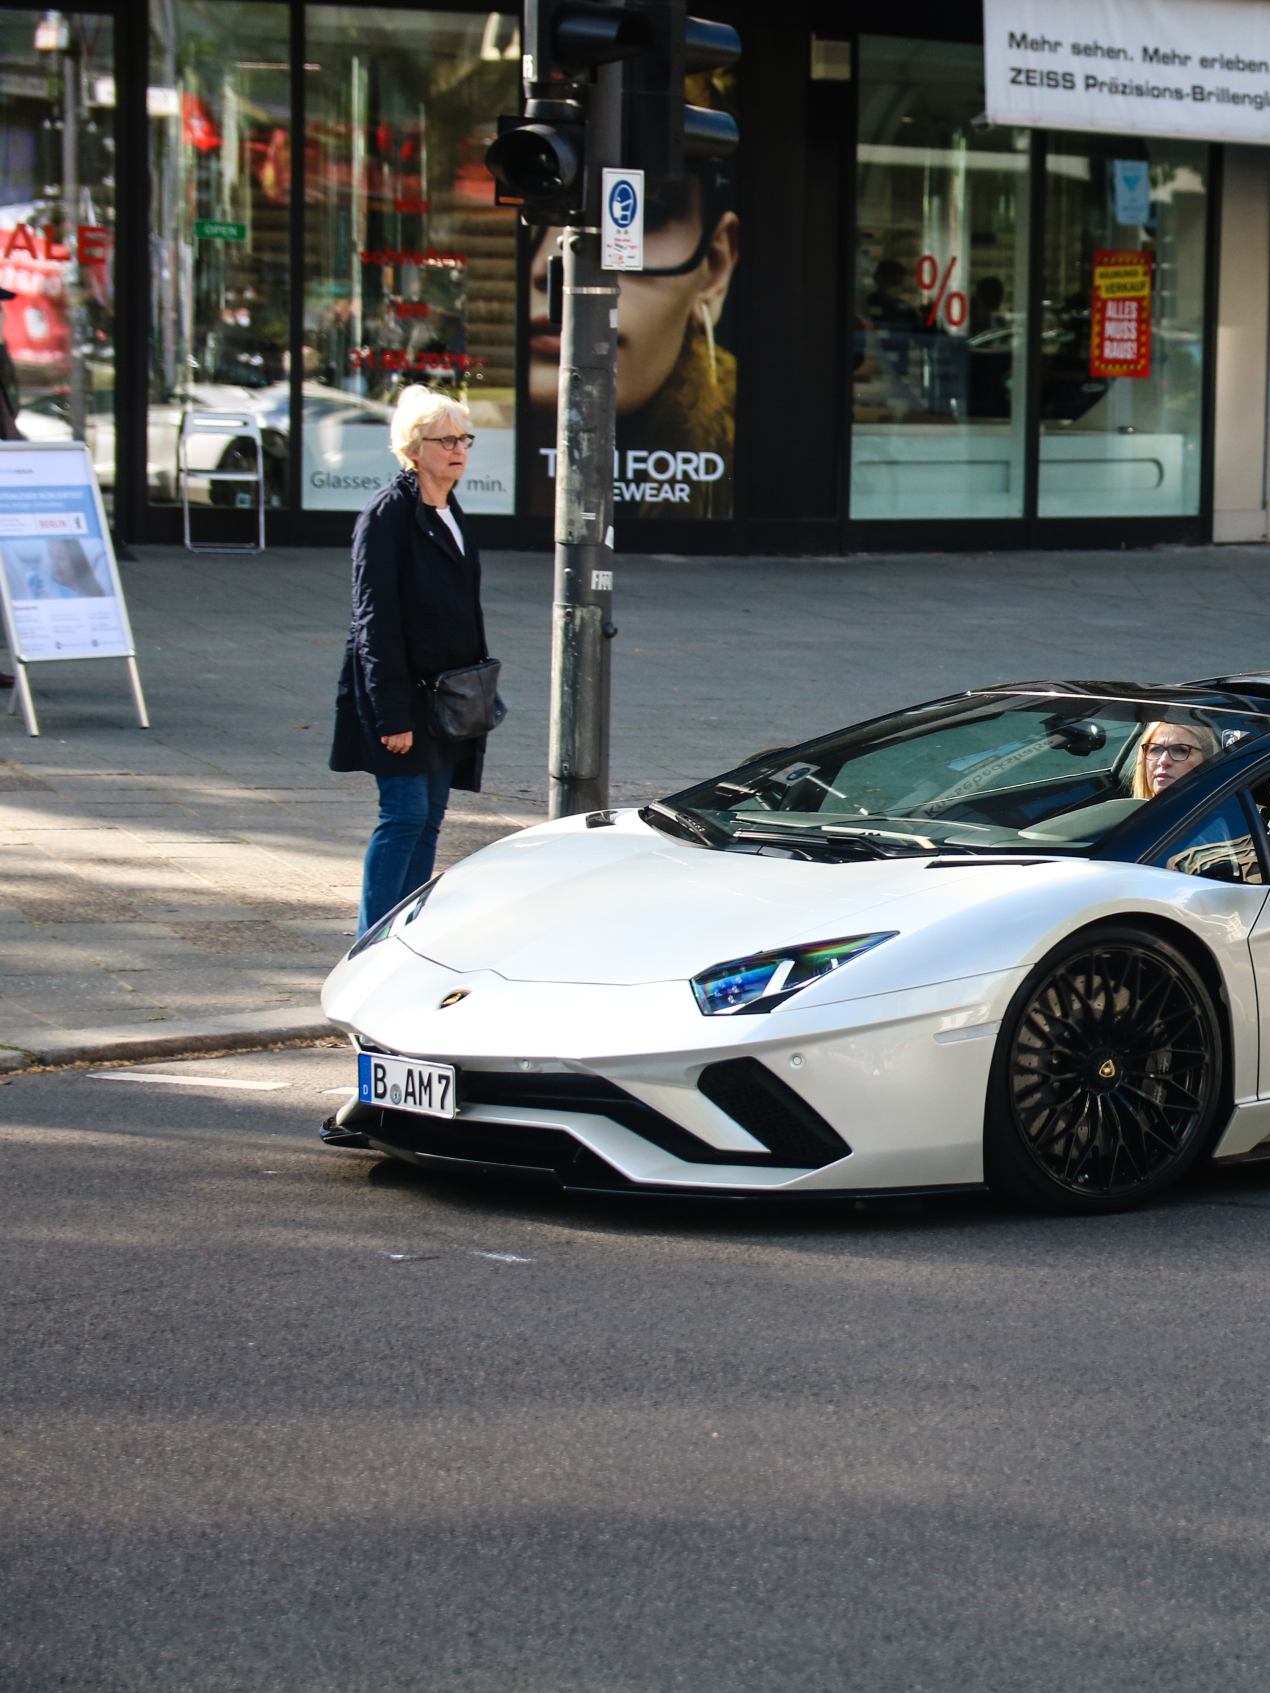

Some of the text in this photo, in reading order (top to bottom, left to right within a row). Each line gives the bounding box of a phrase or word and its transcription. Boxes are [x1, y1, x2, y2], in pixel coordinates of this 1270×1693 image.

[1008, 31, 1063, 52] Mehr
[1071, 42, 1134, 62] sehen.
[1143, 46, 1192, 68] Mehr
[1010, 67, 1076, 90] ZEISS
[394, 196, 432, 214] Wir
[203, 224, 238, 237] OPEN
[3, 223, 107, 264] ALE
[360, 247, 466, 266] schließen
[917, 254, 968, 327] %
[395, 302, 429, 318] am
[1105, 300, 1138, 319] ALLES
[1104, 320, 1138, 339] MUSS
[1103, 340, 1138, 359] RAUS!
[351, 350, 465, 370] 31.05.2021
[626, 450, 725, 481] FORD
[310, 471, 381, 489] Glasses
[467, 475, 507, 493] min.
[613, 482, 690, 502] EWEAR
[363, 1084, 368, 1095] D
[374, 1062, 450, 1110] B AM 7
